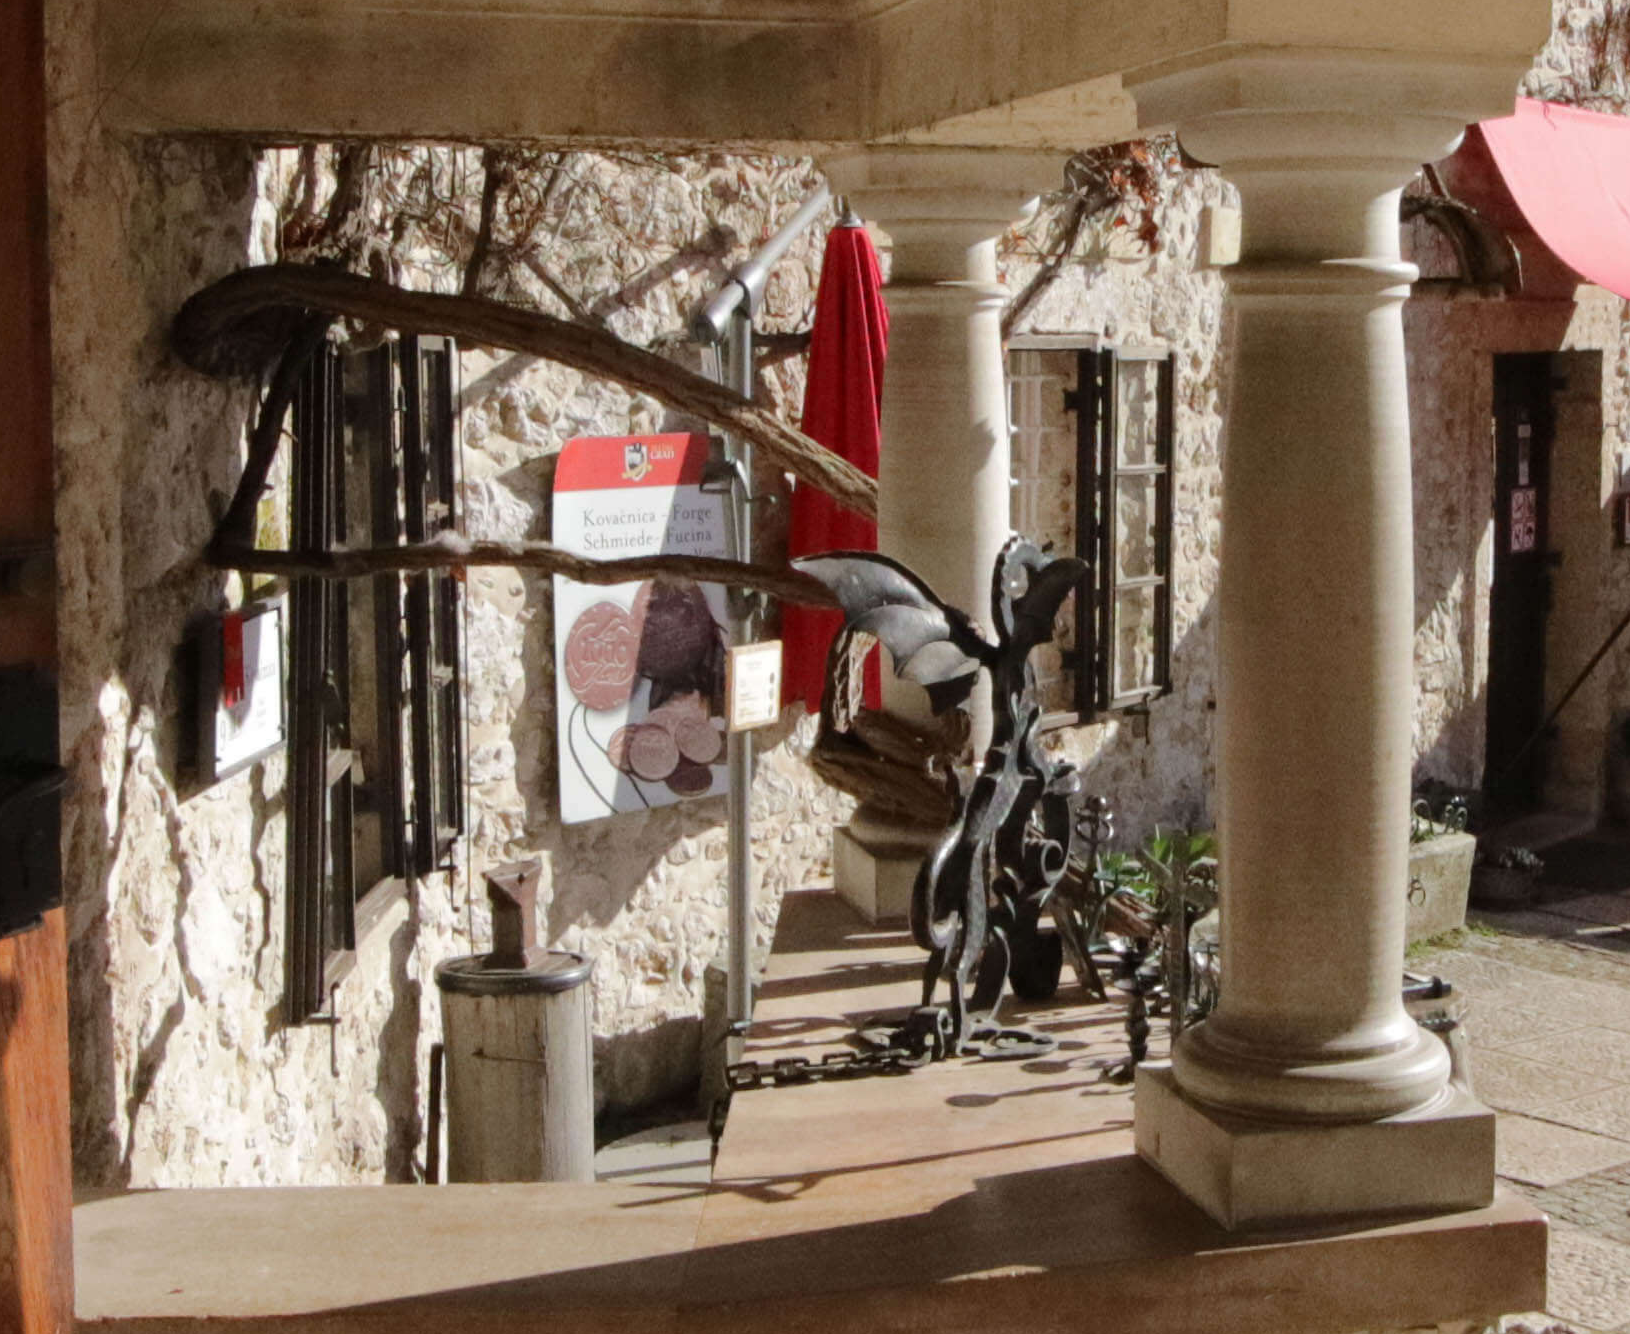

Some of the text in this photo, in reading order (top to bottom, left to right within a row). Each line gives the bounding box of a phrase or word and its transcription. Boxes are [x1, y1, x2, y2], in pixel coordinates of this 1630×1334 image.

[583, 508, 656, 528] Kovačnica
[673, 505, 712, 524] Forge
[666, 527, 712, 545] Fucina
